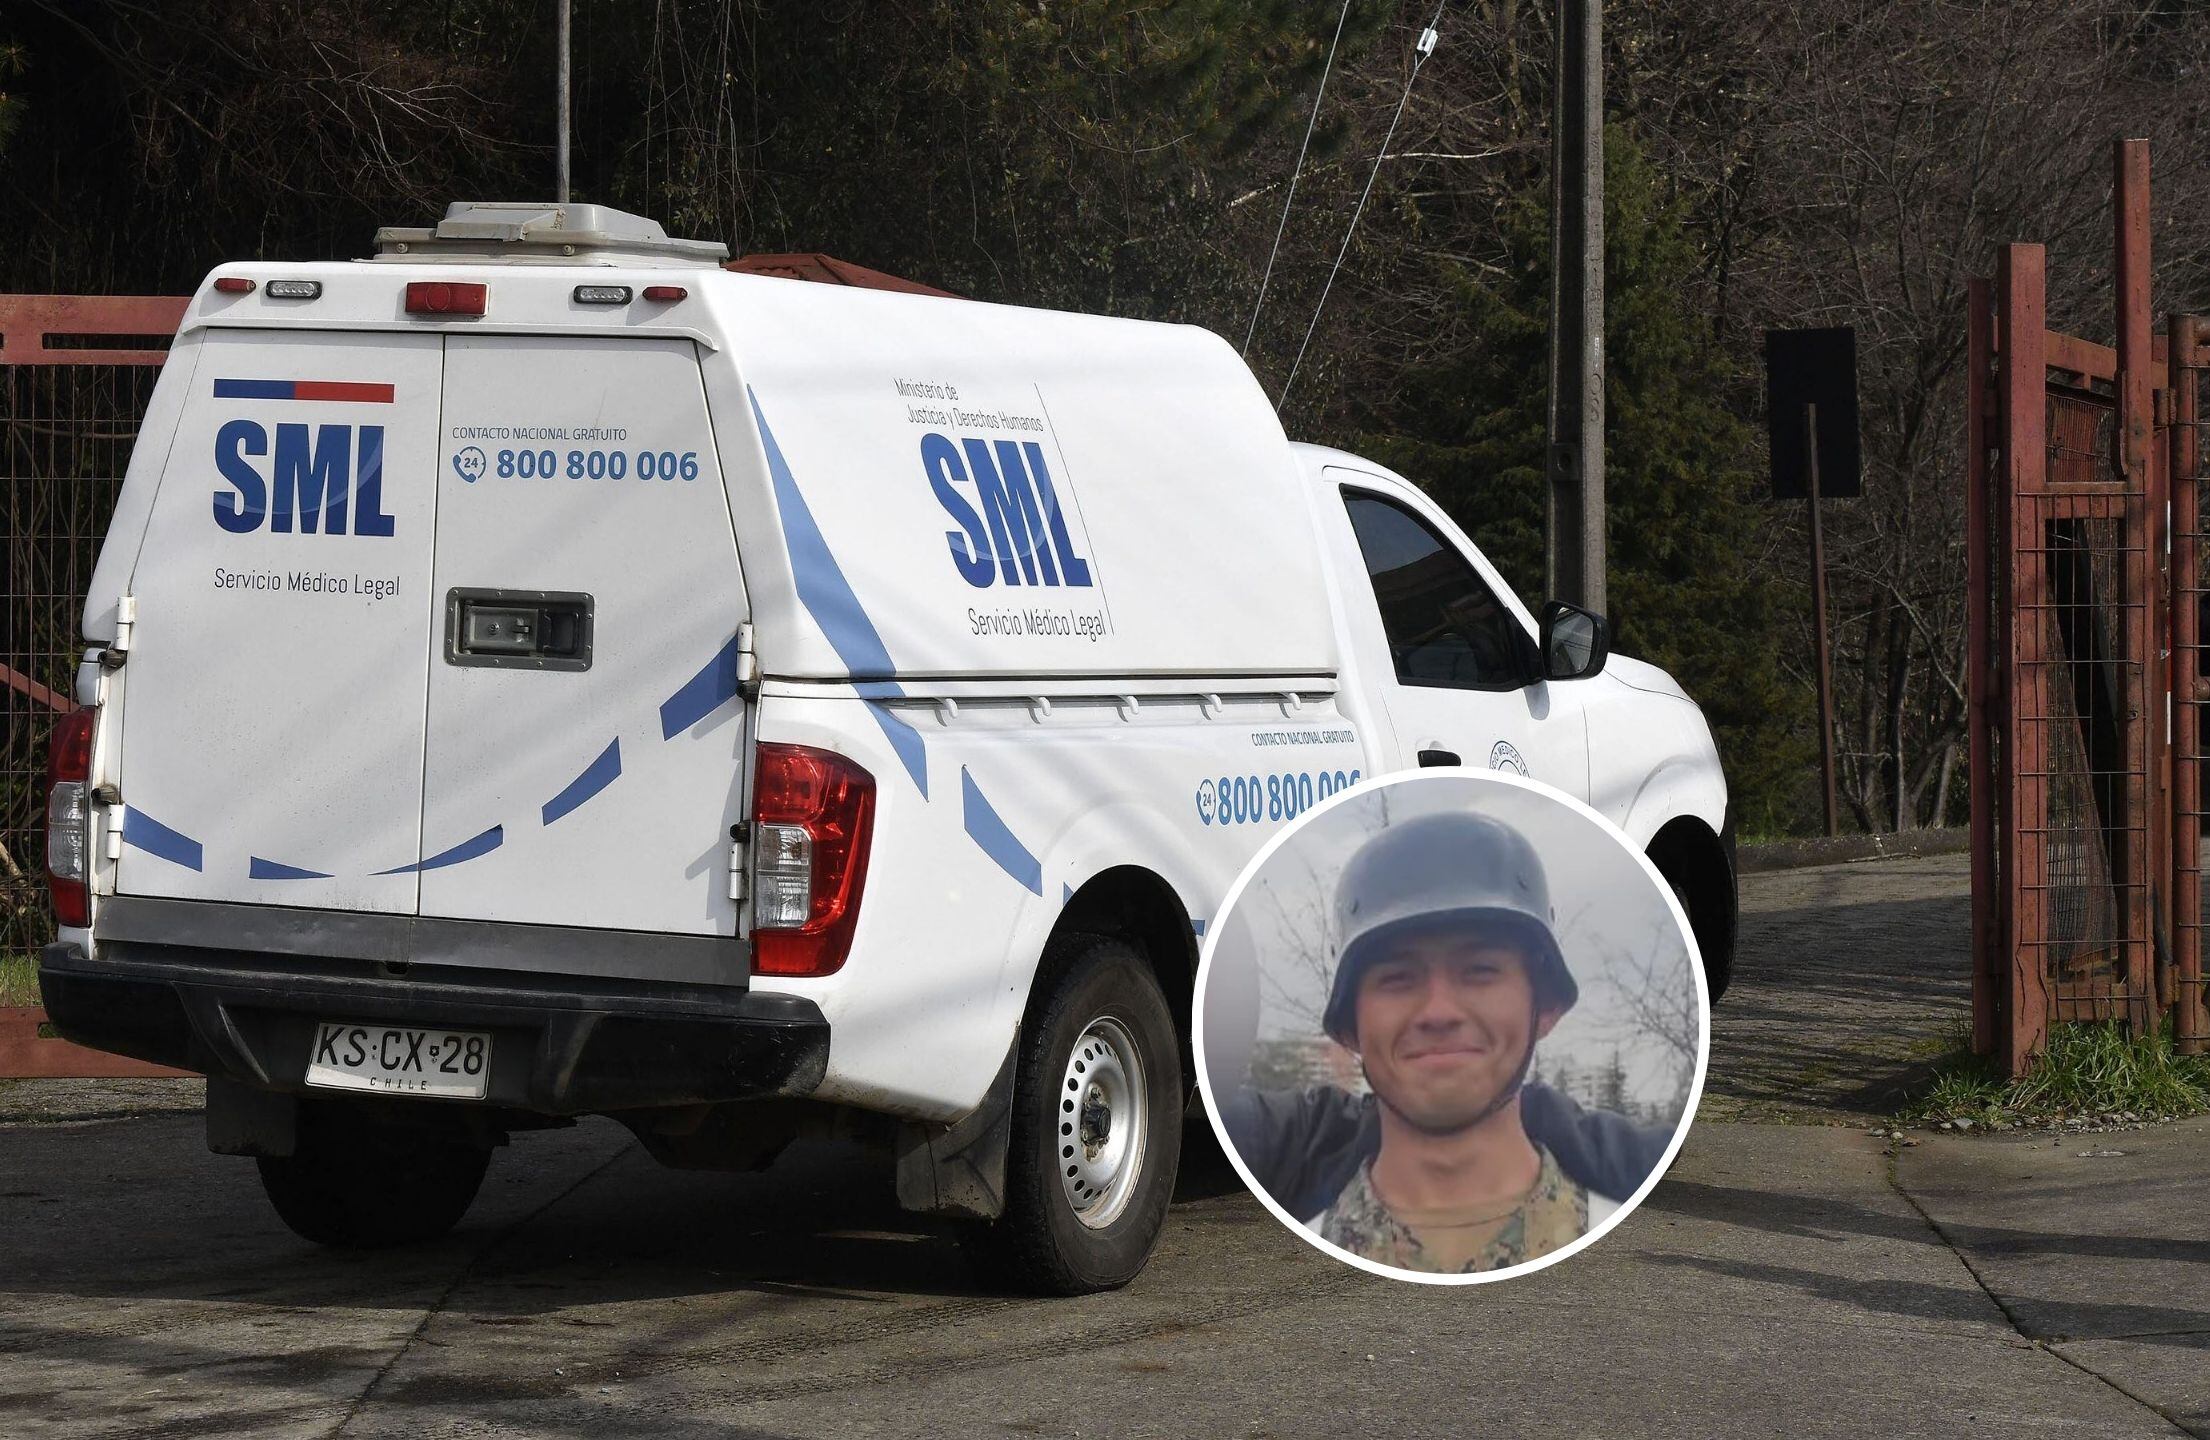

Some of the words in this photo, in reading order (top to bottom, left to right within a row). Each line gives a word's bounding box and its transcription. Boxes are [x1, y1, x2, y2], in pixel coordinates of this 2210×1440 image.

[893, 377, 945, 400] Ministerio
[945, 381, 959, 401] de
[452, 427, 510, 440] CONTACTO
[512, 428, 570, 441] NACIONAL
[572, 428, 627, 441] GRATUITO
[907, 403, 947, 425] Justicia
[946, 411, 955, 431] y
[953, 407, 1000, 429] Derechos
[998, 410, 1044, 432] Humanos
[213, 419, 395, 537] SML
[463, 457, 479, 469] 24
[496, 449, 557, 480] 800
[566, 450, 627, 481] 800
[636, 451, 699, 482] 006
[920, 433, 1093, 588] SML
[214, 567, 281, 591] Servicio
[287, 571, 348, 594] Médico
[354, 574, 400, 600] Legal
[968, 607, 1022, 635] Servicio
[1022, 608, 1070, 635] Médico
[1070, 609, 1106, 642] Legal
[1251, 732, 1287, 746] CONTACTO
[1286, 731, 1323, 745] NACIONAL
[1322, 730, 1354, 743] GRATUITO
[1218, 776, 1263, 826] 800
[1267, 772, 1313, 822] 800
[370, 1077, 428, 1091] CHILE
